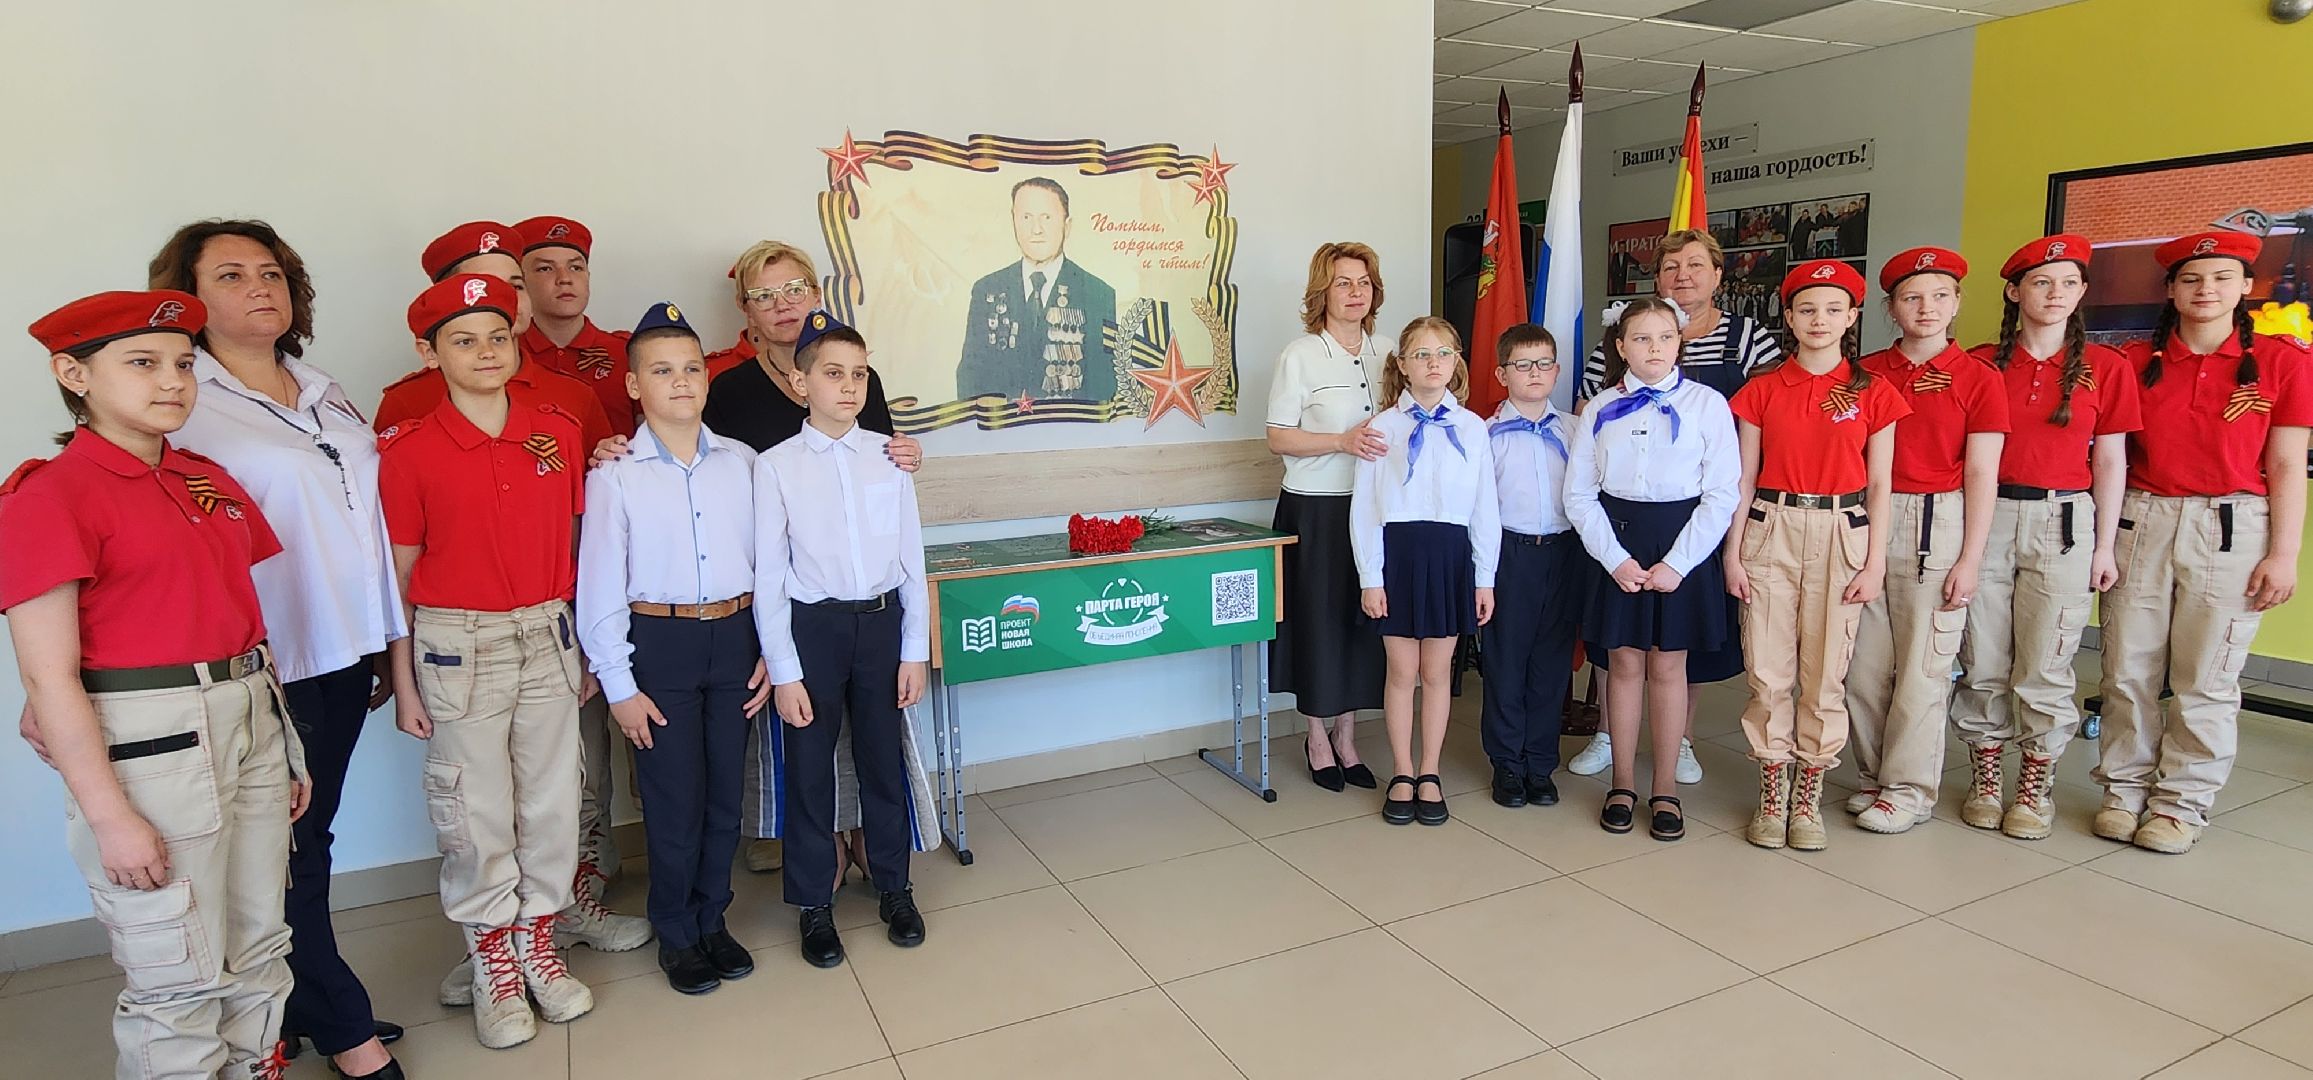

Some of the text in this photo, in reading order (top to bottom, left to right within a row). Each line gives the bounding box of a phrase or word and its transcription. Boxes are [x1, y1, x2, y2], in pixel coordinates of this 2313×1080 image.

[1622, 147, 1665, 167] Ваши
[1711, 143, 1867, 185] наша гордость!
[1091, 213, 1165, 233] Помним,
[1112, 238, 1184, 256] гордимся
[1142, 253, 1210, 269] и чтим!
[1085, 592, 1160, 615] ПАРТА ГЕРОЯ
[1000, 618, 1032, 630] ПРОЕКТ
[1001, 629, 1030, 640] НОВАЯ
[1002, 638, 1033, 650] ШКОЛА
